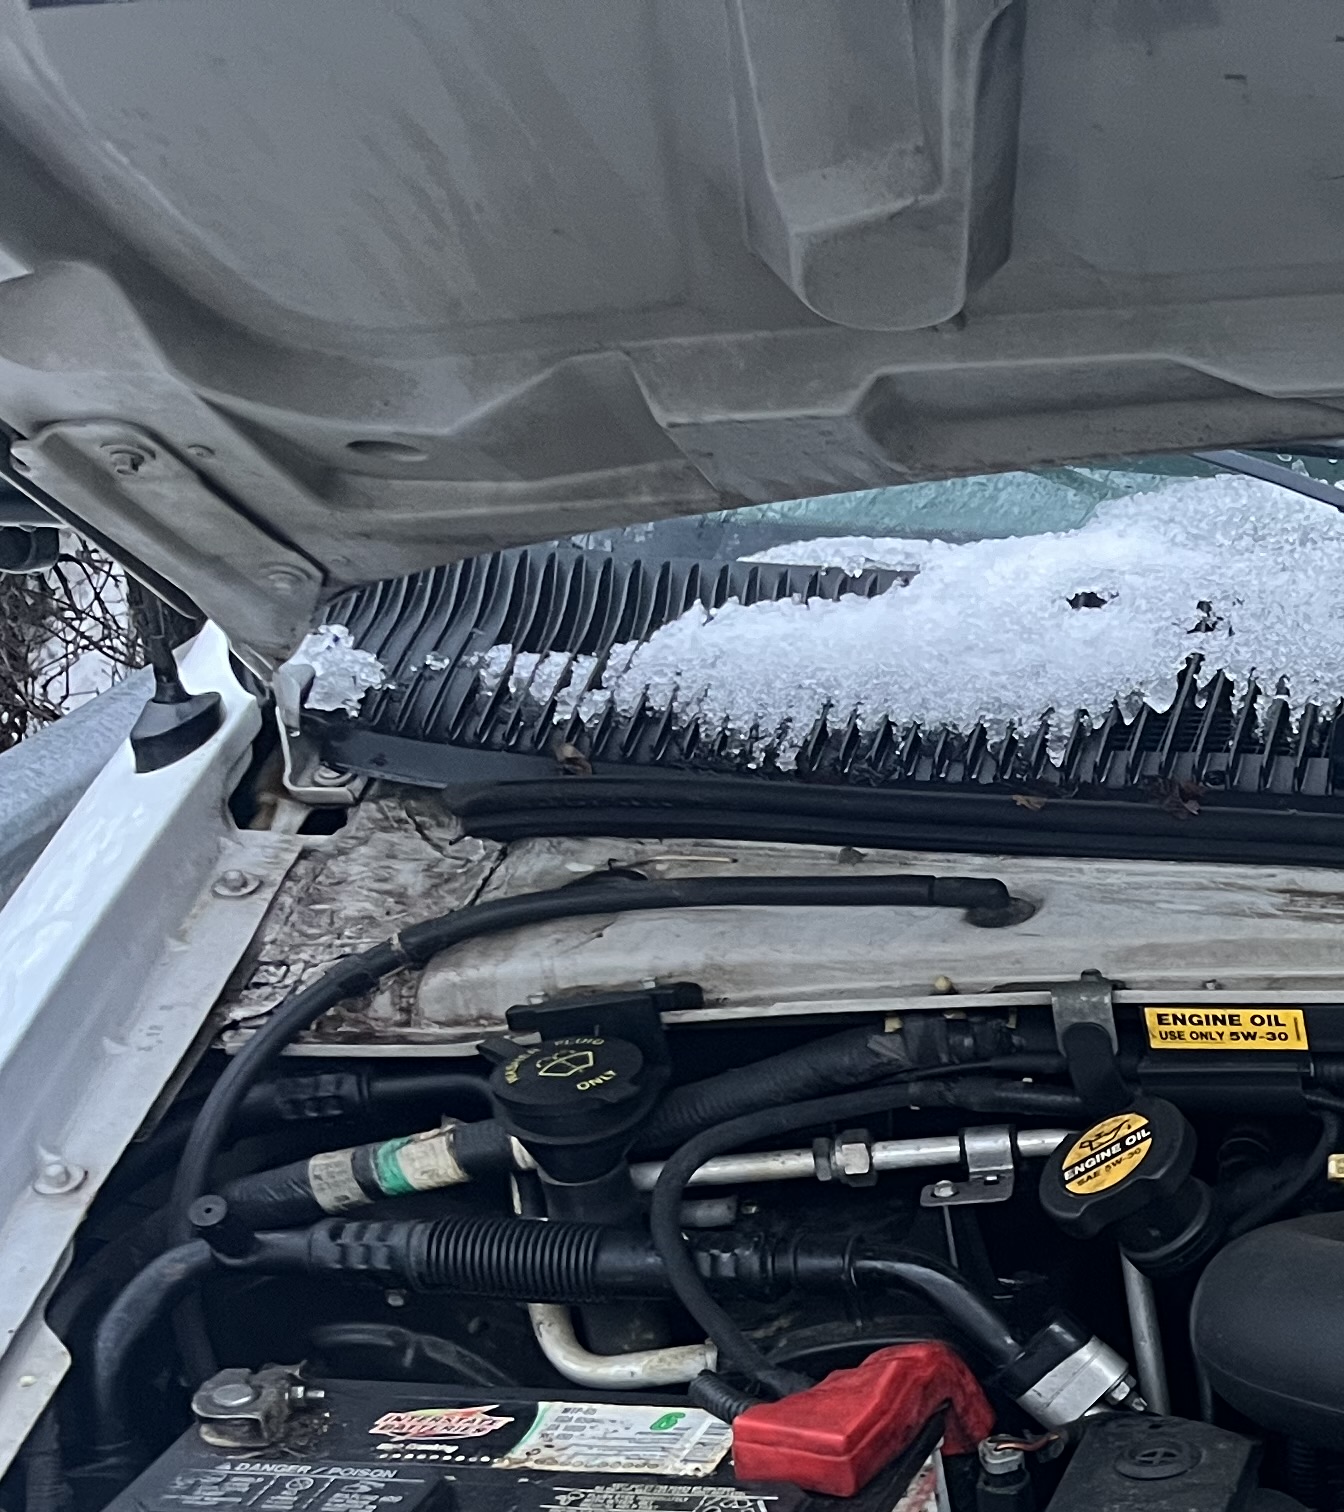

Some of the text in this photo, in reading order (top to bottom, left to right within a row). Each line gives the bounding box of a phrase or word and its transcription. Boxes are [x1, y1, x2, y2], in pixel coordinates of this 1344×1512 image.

[1156, 1013, 1287, 1027] ENGINE OIL
[1158, 1030, 1289, 1042] USE ONLY 5W-30
[1064, 1127, 1152, 1181] ENGINE OIL
[1076, 1147, 1142, 1188] SAE 5W-30
[234, 1461, 312, 1475] DANGER
[327, 1466, 398, 1479] POISON
